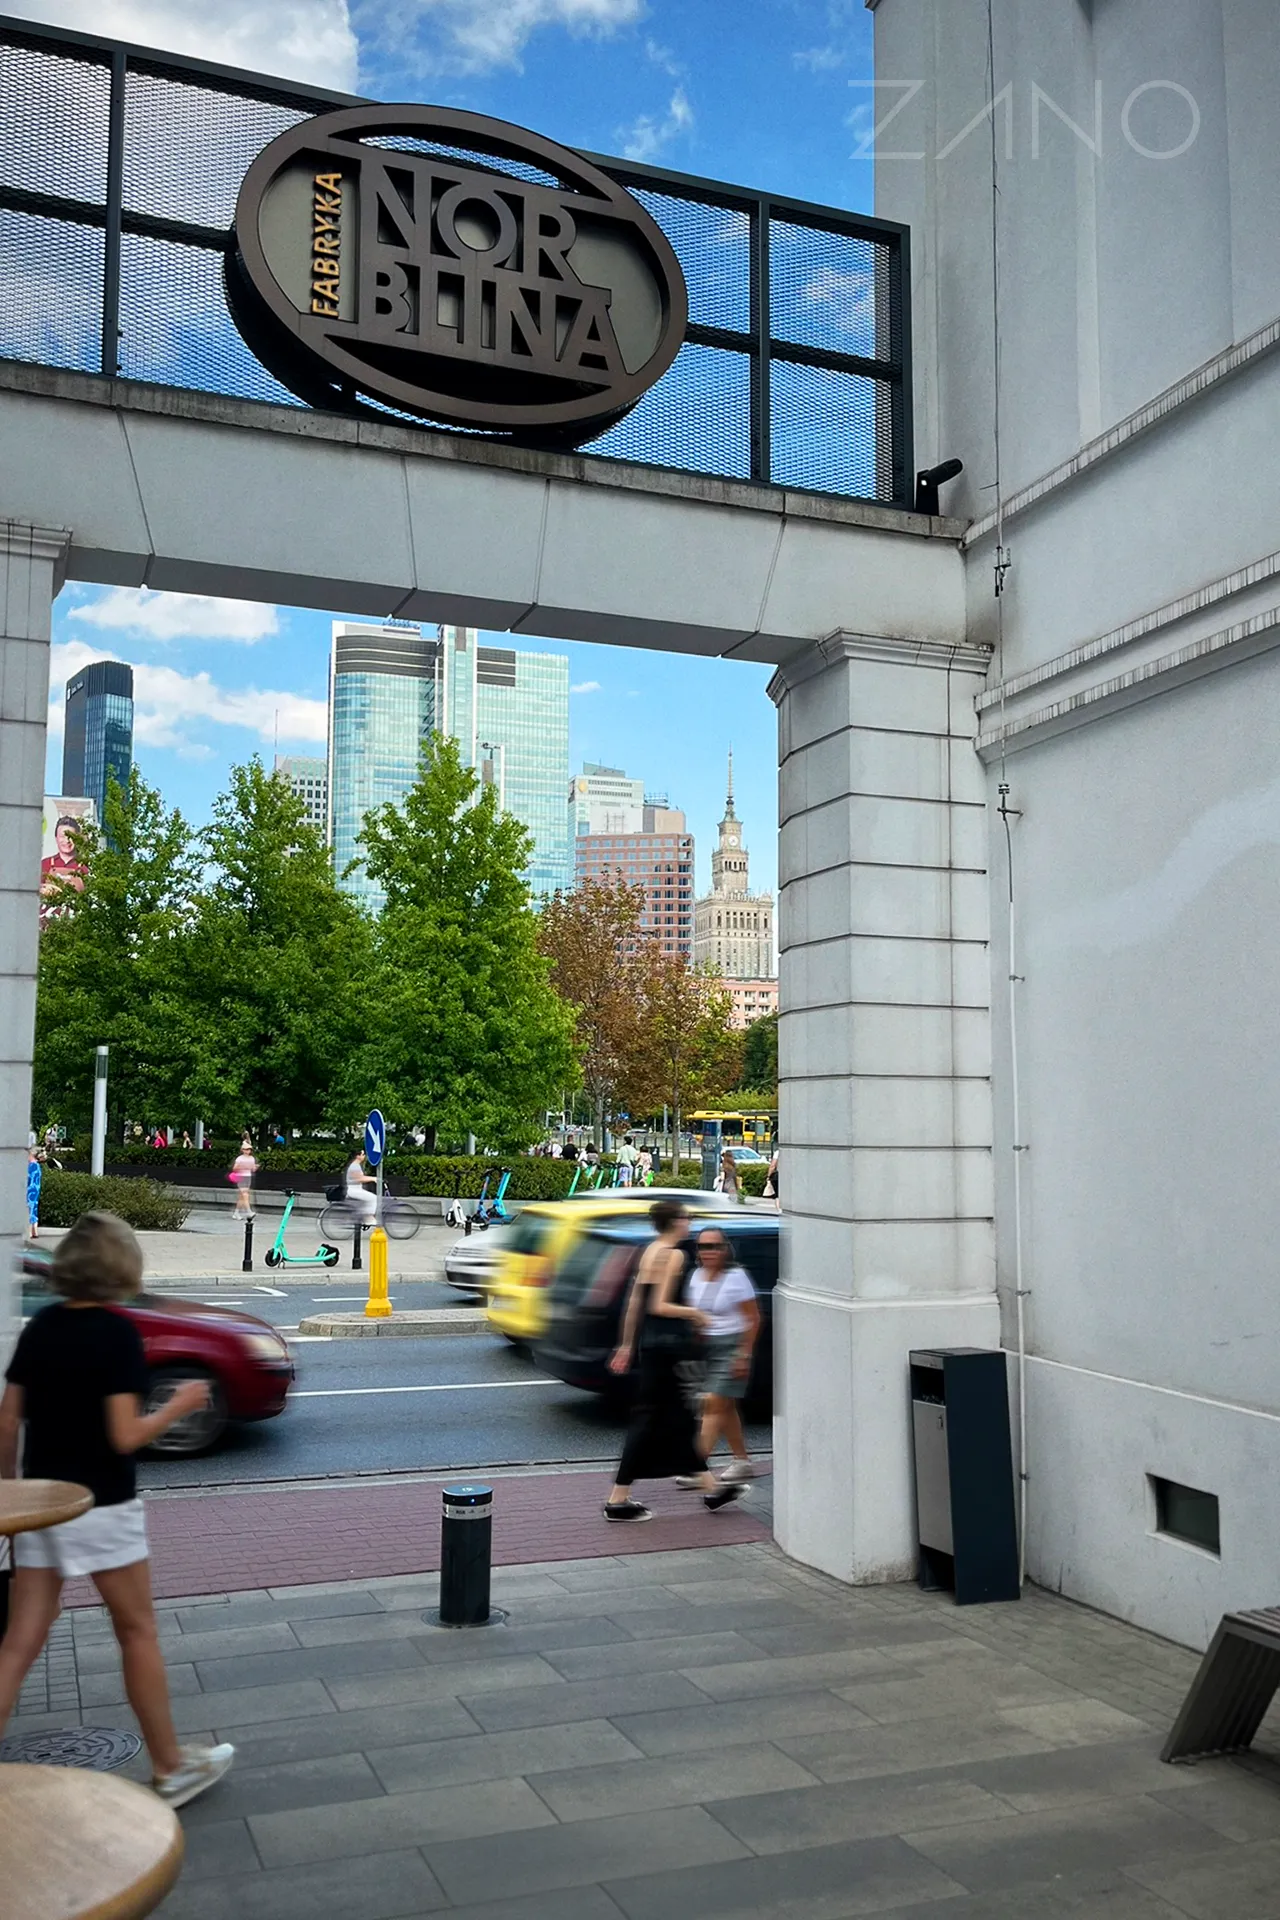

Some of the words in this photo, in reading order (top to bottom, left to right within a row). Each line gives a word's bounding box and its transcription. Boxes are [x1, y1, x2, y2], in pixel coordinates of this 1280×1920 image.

[312, 172, 342, 318] FABRYKA
[361, 160, 583, 284] NOR
[360, 253, 624, 376] BLINA
